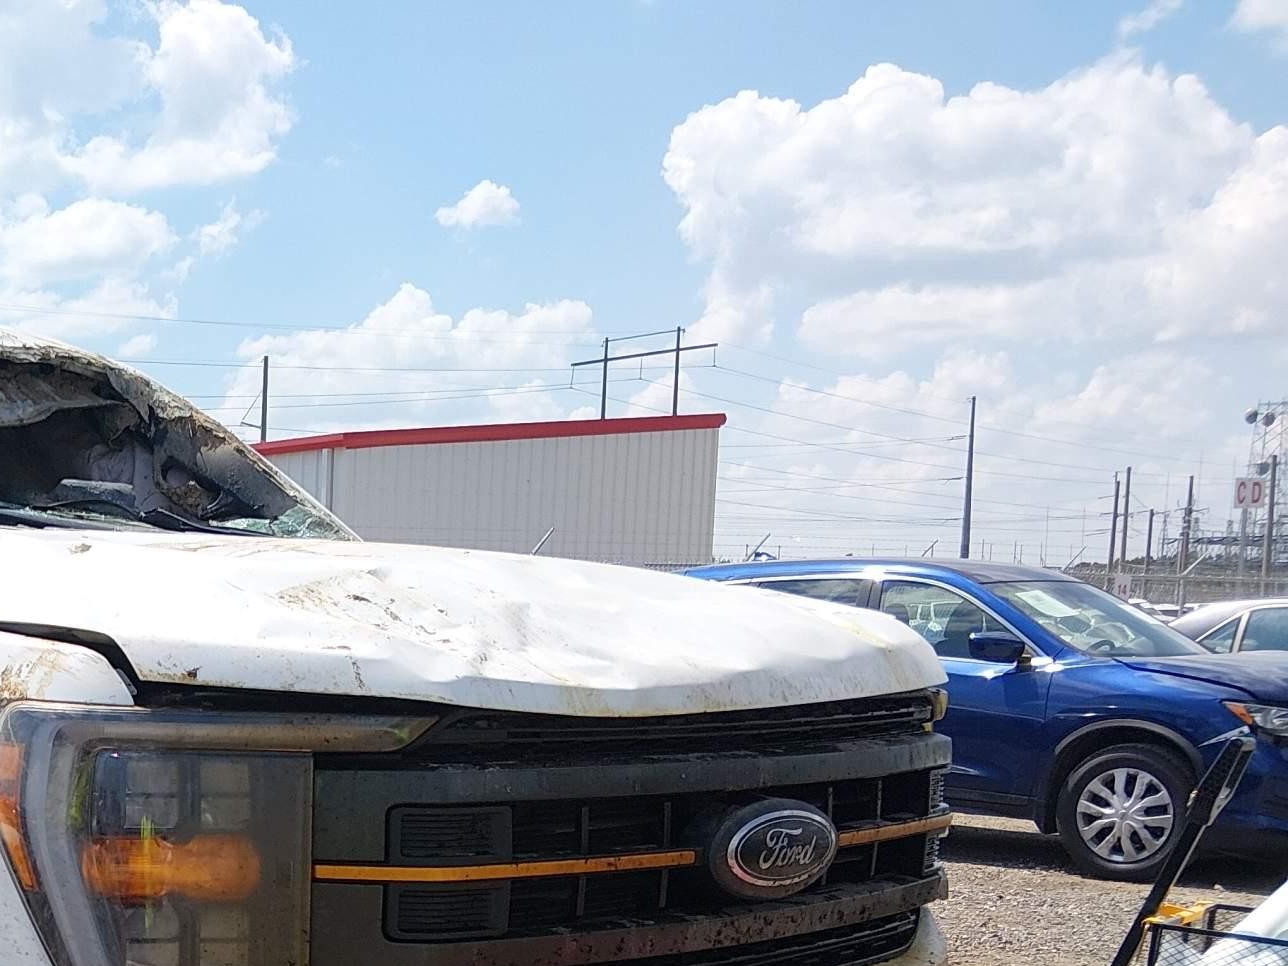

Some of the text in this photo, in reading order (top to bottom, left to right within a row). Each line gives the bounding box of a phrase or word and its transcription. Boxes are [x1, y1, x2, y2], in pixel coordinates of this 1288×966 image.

[1237, 481, 1262, 504] C D
[758, 827, 817, 870] Ford
